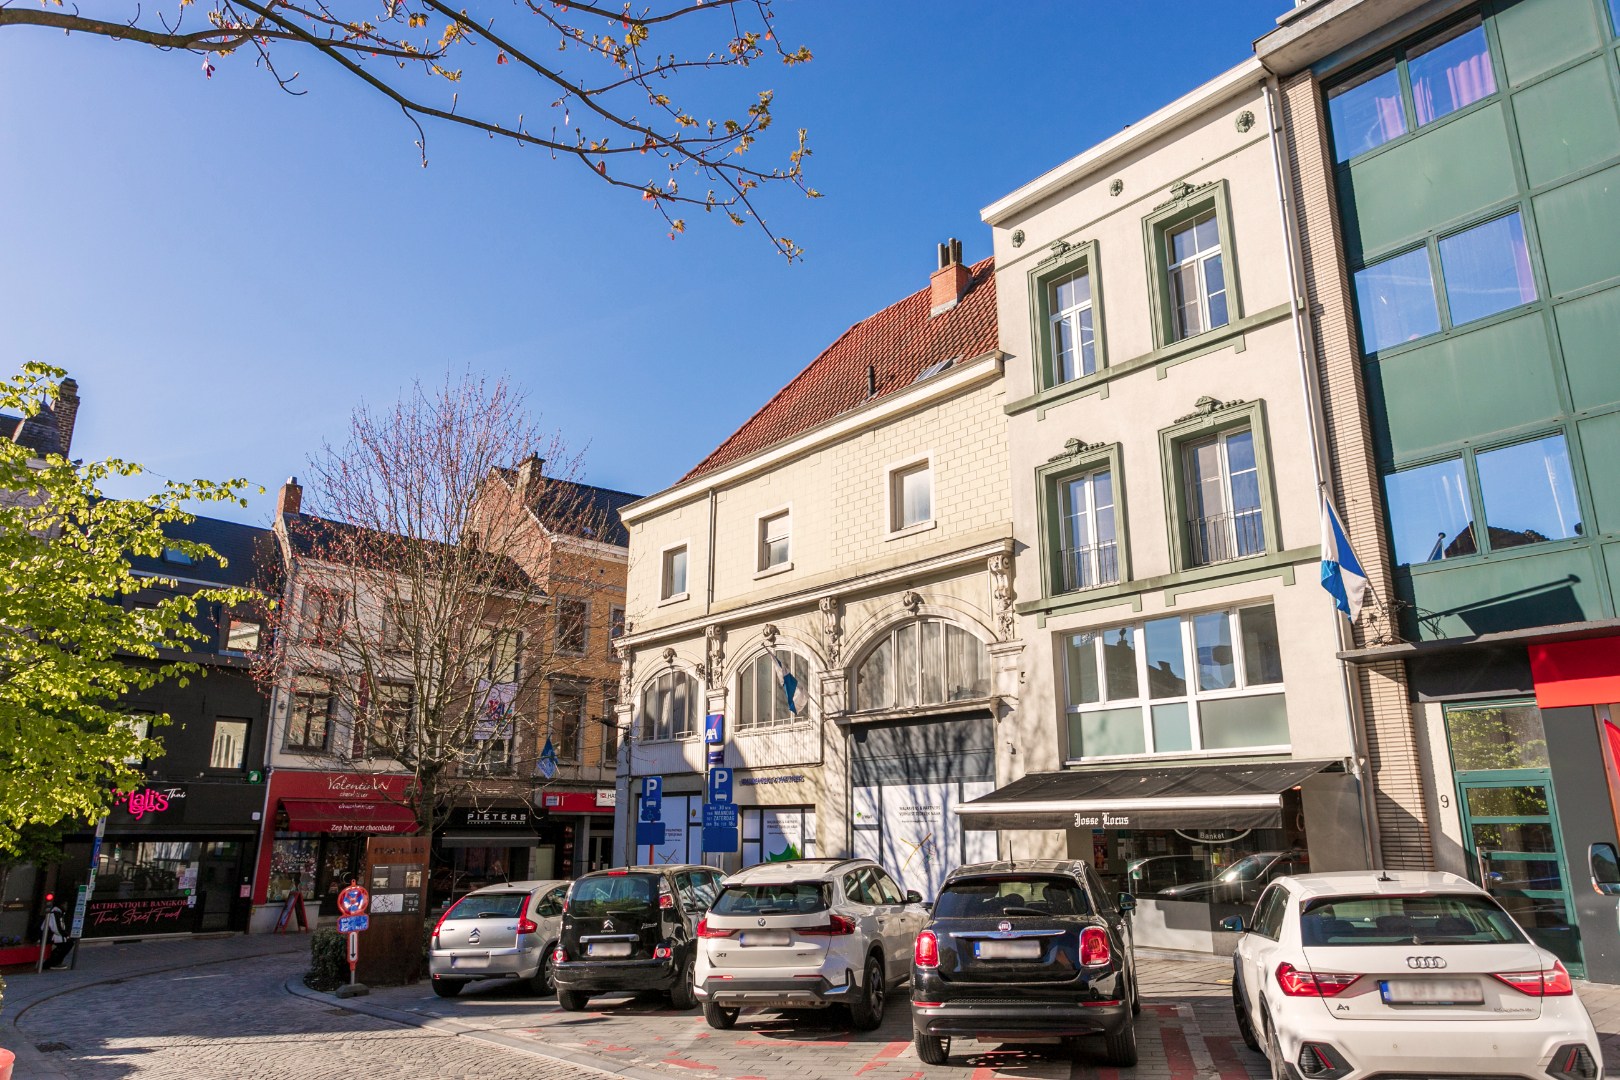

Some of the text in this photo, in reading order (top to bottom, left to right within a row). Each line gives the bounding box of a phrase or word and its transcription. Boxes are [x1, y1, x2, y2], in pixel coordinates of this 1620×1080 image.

[715, 770, 728, 789] P
[163, 787, 187, 801] Thai
[646, 779, 658, 797] P
[1440, 794, 1450, 809] 9
[467, 813, 527, 821] PIETERS
[1074, 812, 1130, 829] Josse Locus
[1055, 832, 1061, 842] 7
[1200, 832, 1225, 841] Banket
[90, 901, 149, 910] AUTHENTIQUE
[90, 906, 183, 926] Thai Street Food
[1336, 1003, 1350, 1011] A1
